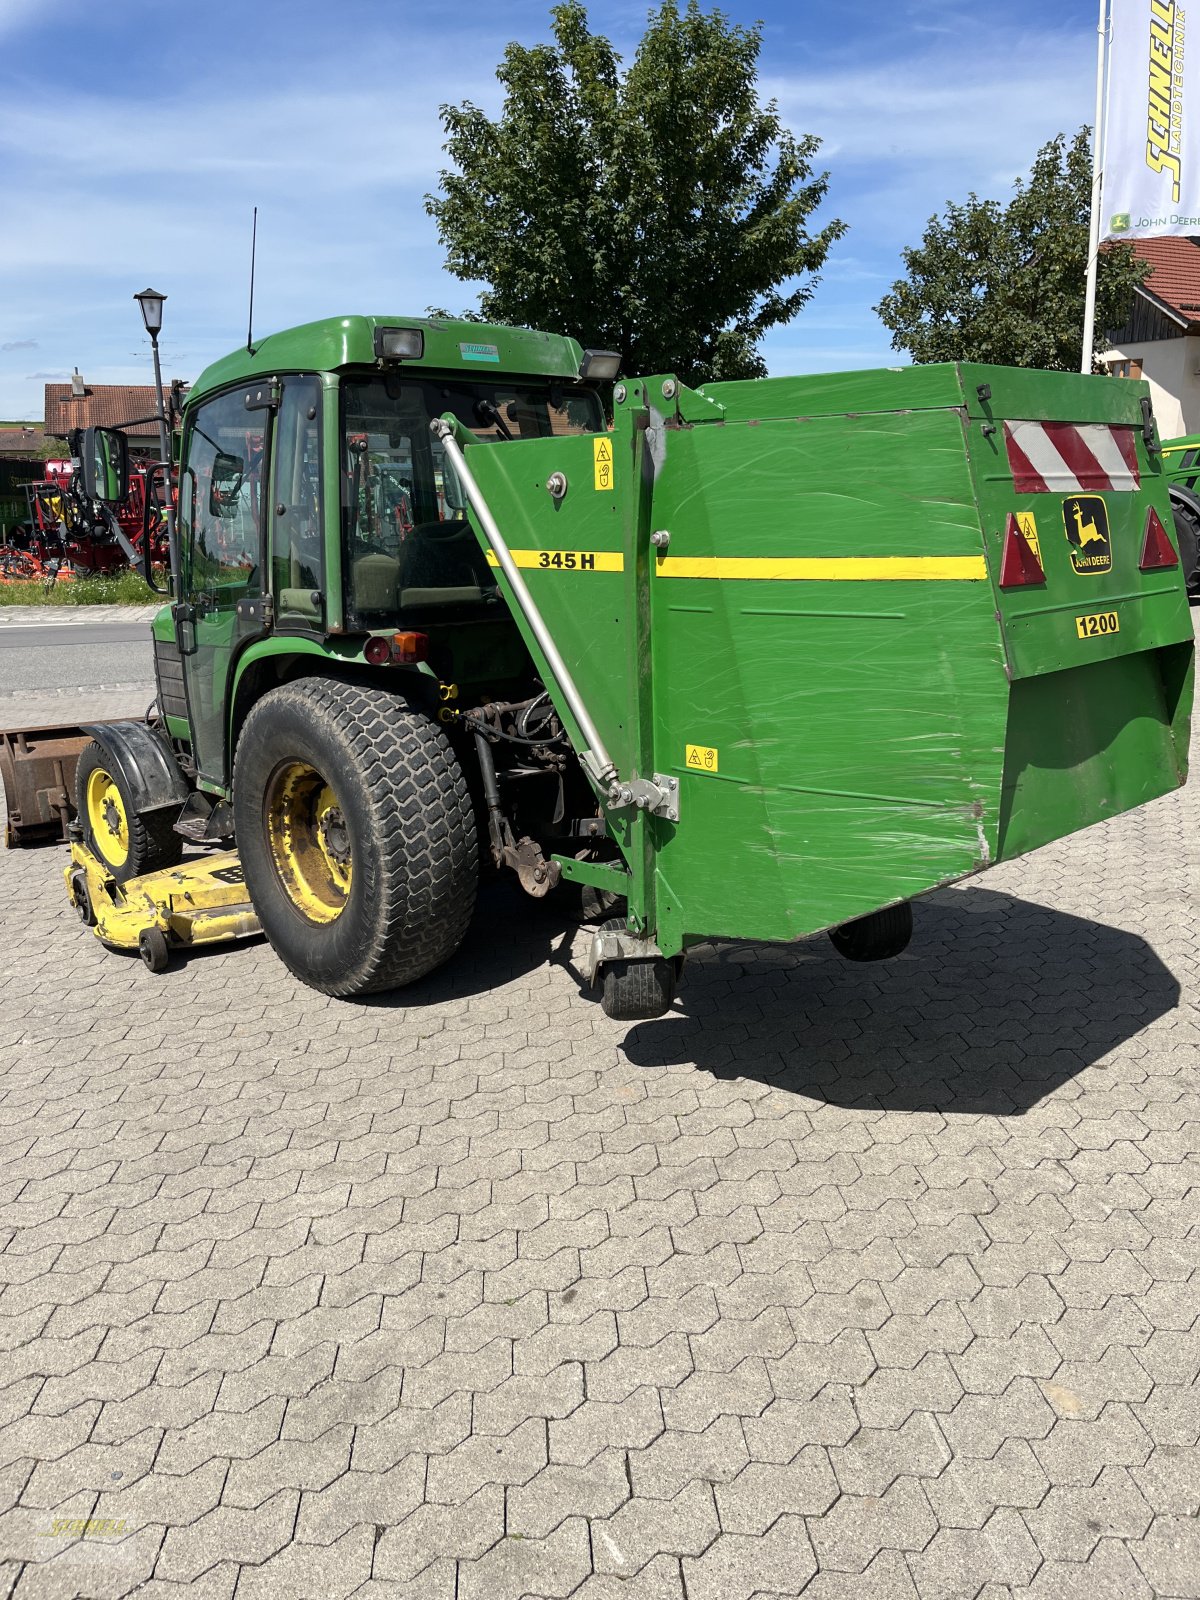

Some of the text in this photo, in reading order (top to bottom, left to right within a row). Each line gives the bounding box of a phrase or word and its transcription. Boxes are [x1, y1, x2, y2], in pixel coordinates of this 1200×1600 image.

[1170, 4, 1186, 155] LANDTECHNIK
[1146, 0, 1182, 203] SCHNELL
[1134, 216, 1167, 228] JOHN
[538, 552, 595, 570] 345 H
[1075, 555, 1111, 568] JOHN DEERE
[1079, 613, 1117, 636] 1200
